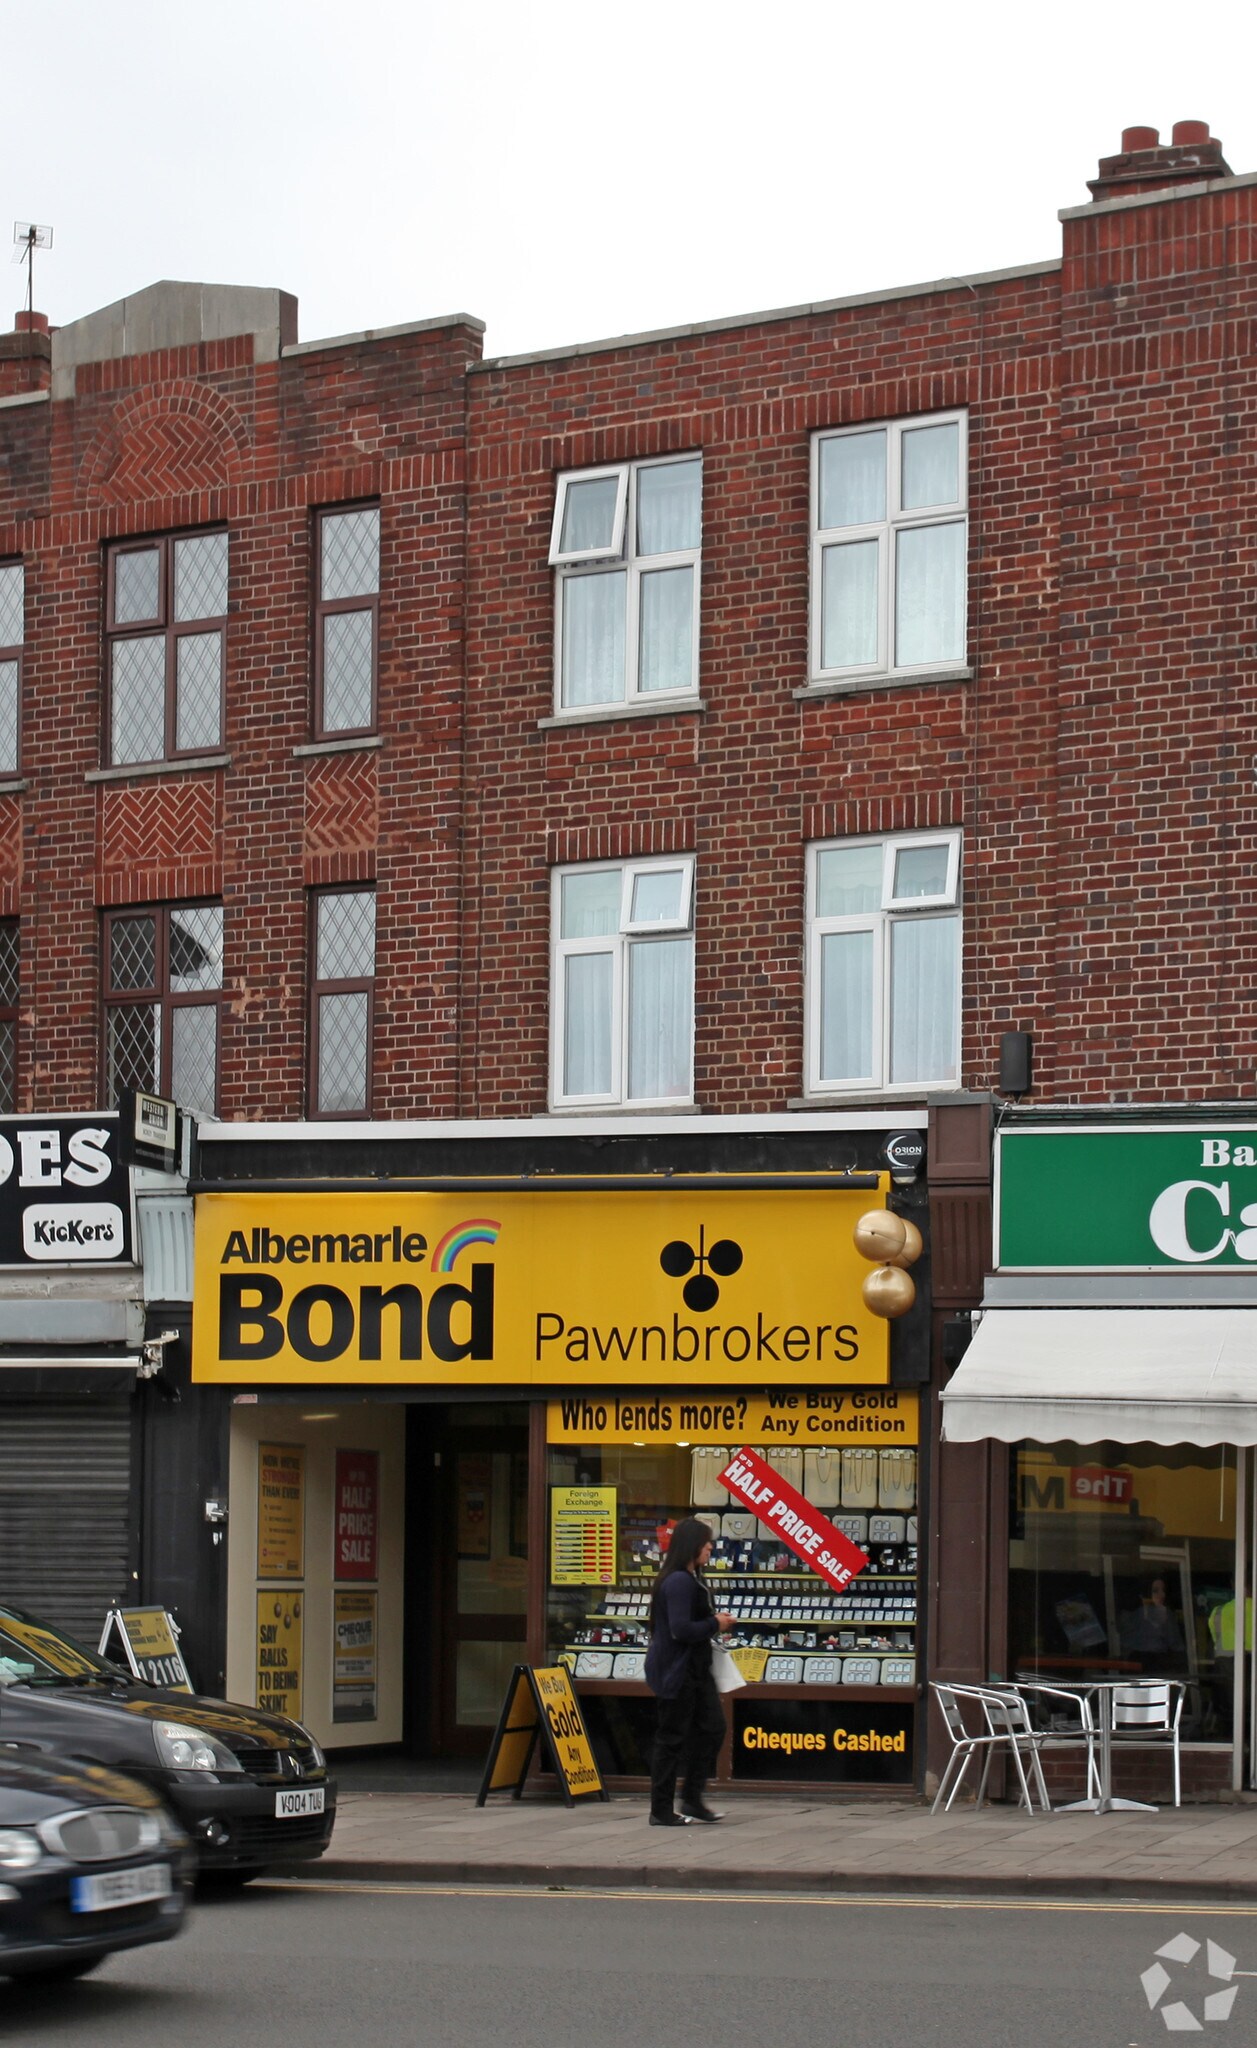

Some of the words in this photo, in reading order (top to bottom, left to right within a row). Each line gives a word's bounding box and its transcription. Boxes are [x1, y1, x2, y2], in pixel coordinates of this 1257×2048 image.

[0, 1128, 112, 1187] ES
[895, 1146, 922, 1154] ORION
[220, 1226, 428, 1264] Albemarle
[219, 1263, 495, 1363] Bond
[536, 1312, 859, 1362] Pawnbrokers
[768, 1392, 799, 1409] We
[806, 1392, 844, 1413] Buy
[851, 1391, 898, 1409] Gold
[561, 1398, 607, 1431] Who
[615, 1399, 672, 1431] lends
[679, 1397, 747, 1431] more?
[761, 1415, 800, 1436] Any
[806, 1415, 905, 1433] Condition
[342, 1486, 372, 1509] HALF
[565, 1499, 603, 1507] Exchange
[569, 1490, 599, 1498] Foreign
[339, 1513, 373, 1536] PRICE
[724, 1460, 775, 1505] HALF
[767, 1500, 824, 1555] PRICE
[817, 1550, 852, 1584] SALE
[341, 1539, 371, 1563] SALE
[260, 1624, 278, 1644] SAY
[338, 1620, 372, 1637] CHEQUE
[260, 1647, 288, 1667] BALLS
[258, 1671, 272, 1691] TO
[273, 1671, 298, 1690] BEING
[538, 1678, 552, 1695] We
[551, 1676, 567, 1695] Buy
[546, 1701, 583, 1739] Gold
[743, 1727, 826, 1754] Cheques
[833, 1729, 905, 1752] Cashed
[566, 1745, 582, 1764] Any
[564, 1767, 597, 1785] Condition
